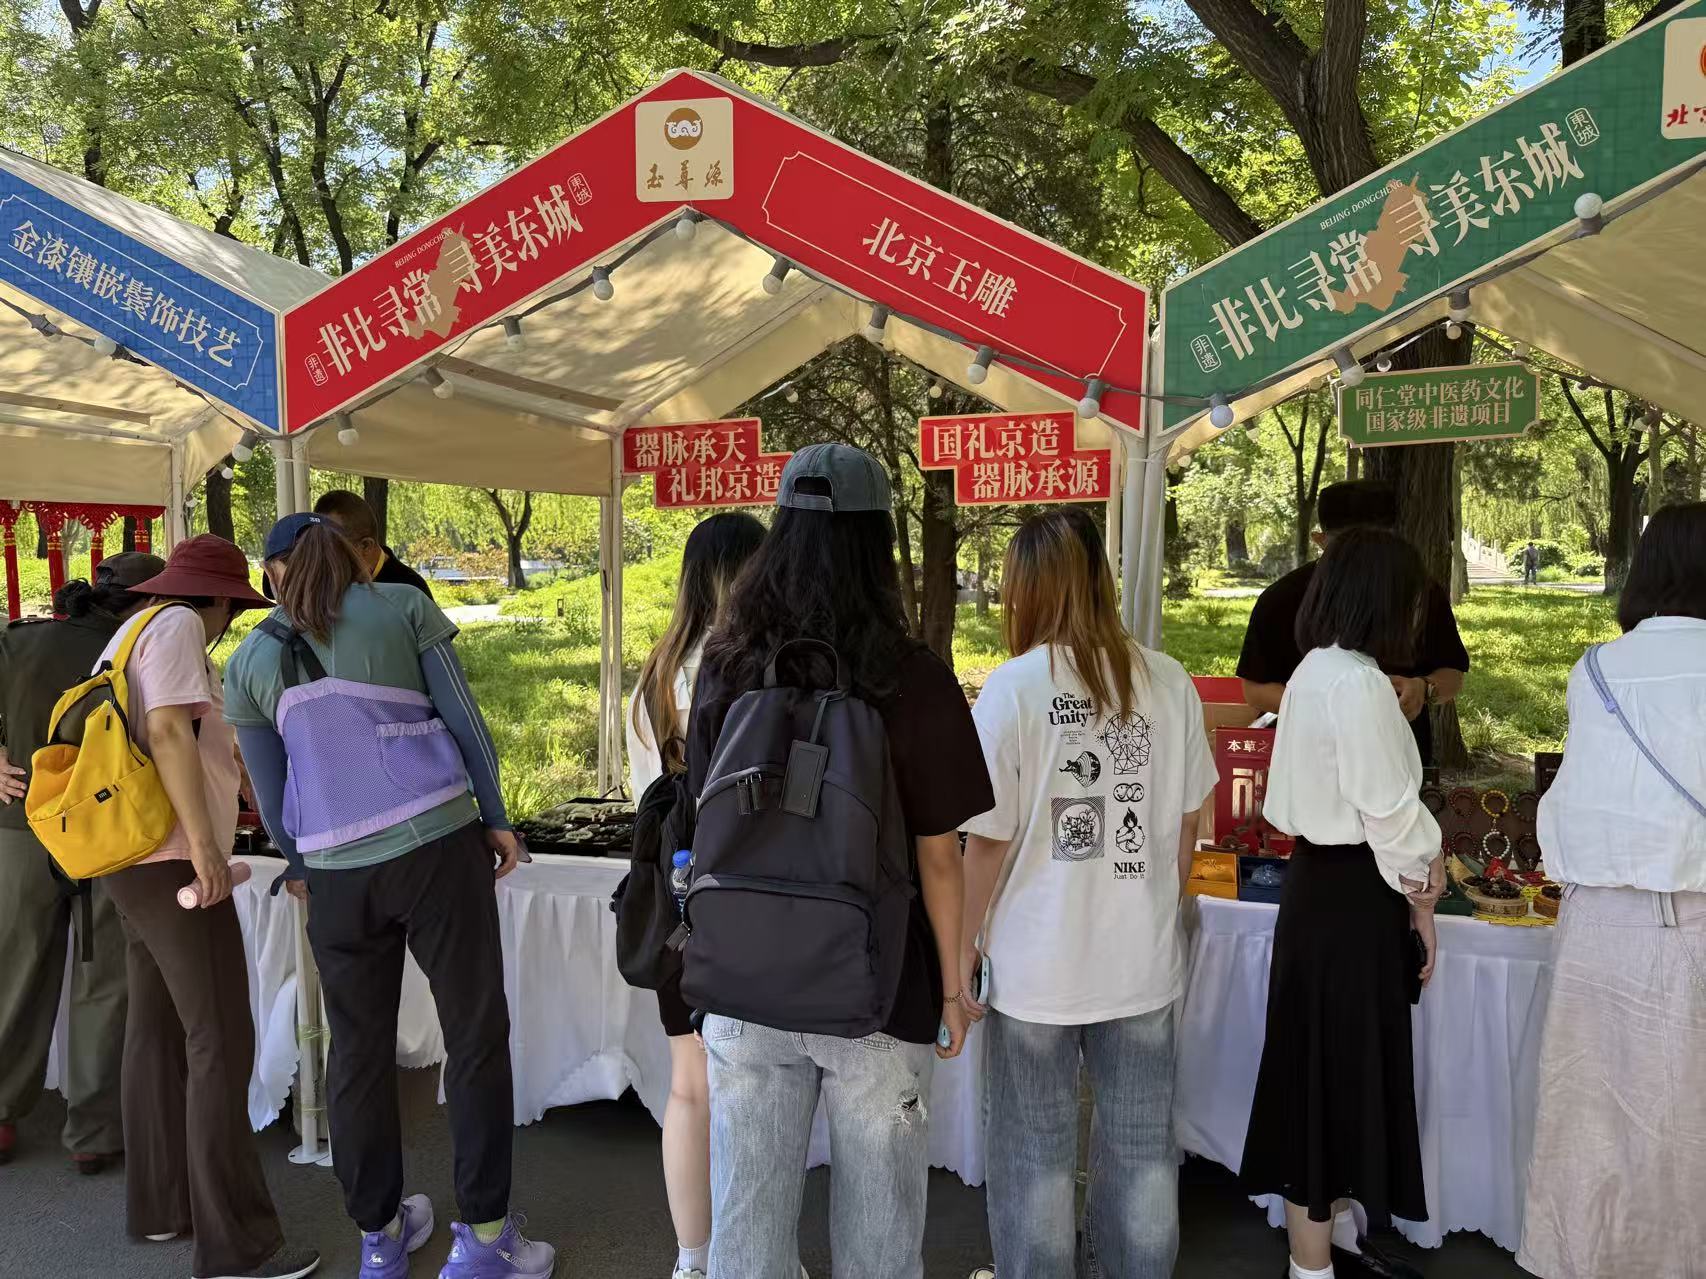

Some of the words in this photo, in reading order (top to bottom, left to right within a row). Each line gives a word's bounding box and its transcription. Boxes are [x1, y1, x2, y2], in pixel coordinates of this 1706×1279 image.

[1319, 208, 1351, 231] BEIJING
[1351, 179, 1403, 212] DONGCHENG
[394, 251, 418, 269] BEIJING
[417, 230, 453, 255] DONGCHENG
[1208, 229, 1382, 361] 非比寻常
[1389, 122, 1585, 257] 寻美东城
[317, 268, 442, 377] 非比寻常
[444, 184, 584, 294] 寻美东城
[862, 217, 1018, 318] 北京玉雕
[1355, 375, 1525, 411] 同仁堂中医药文化
[1366, 401, 1511, 435] 国家级非遗项目
[634, 427, 747, 468] 器脉承天
[933, 418, 1060, 462] 国礼京造
[667, 462, 782, 503] 礼邦京造
[972, 456, 1100, 499] 器脉承源
[1048, 710, 1089, 727] Unity
[1052, 696, 1093, 711] Great
[1114, 861, 1146, 873] NIKE
